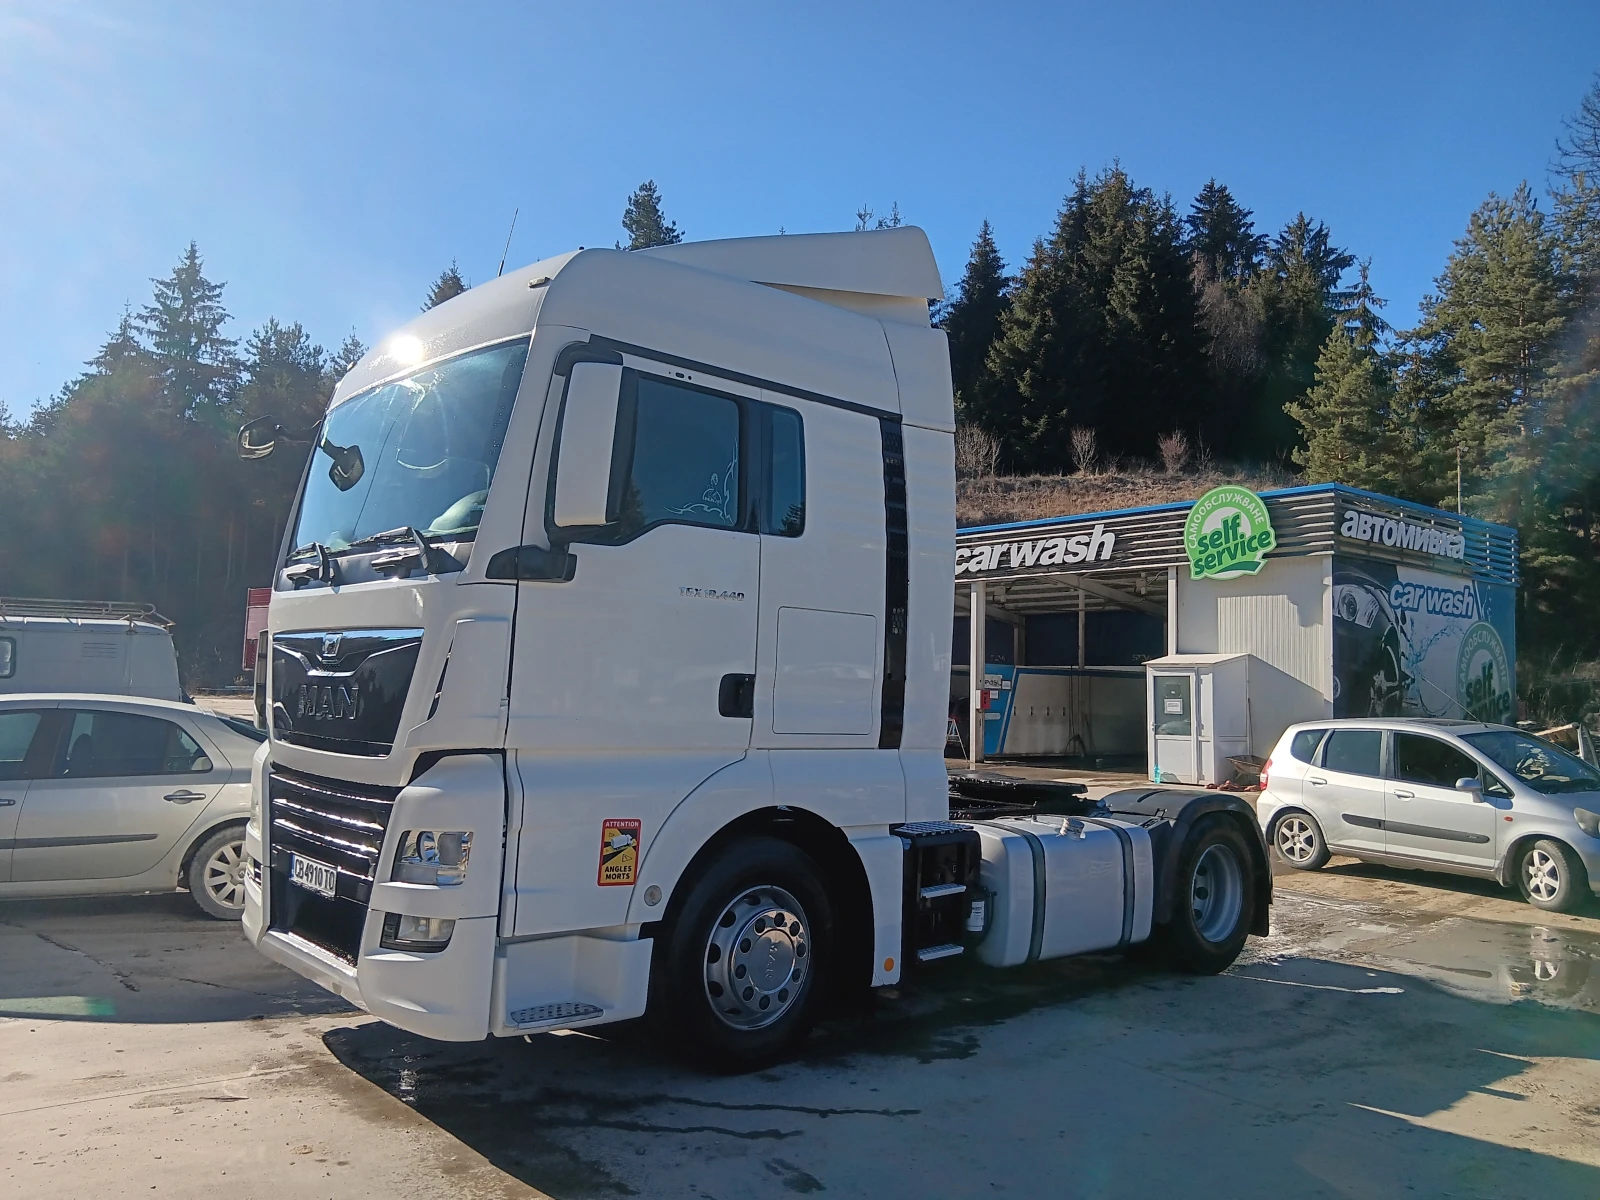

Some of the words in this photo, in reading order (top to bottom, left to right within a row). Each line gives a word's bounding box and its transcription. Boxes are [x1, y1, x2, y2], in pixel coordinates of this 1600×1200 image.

[1188, 493, 1264, 549] САМООБСЛУЖВАНЕ
[1197, 514, 1240, 555] self
[1193, 530, 1272, 576] service
[297, 684, 360, 720] MAN
[1465, 659, 1494, 708] self
[604, 865, 632, 873] ANGLES
